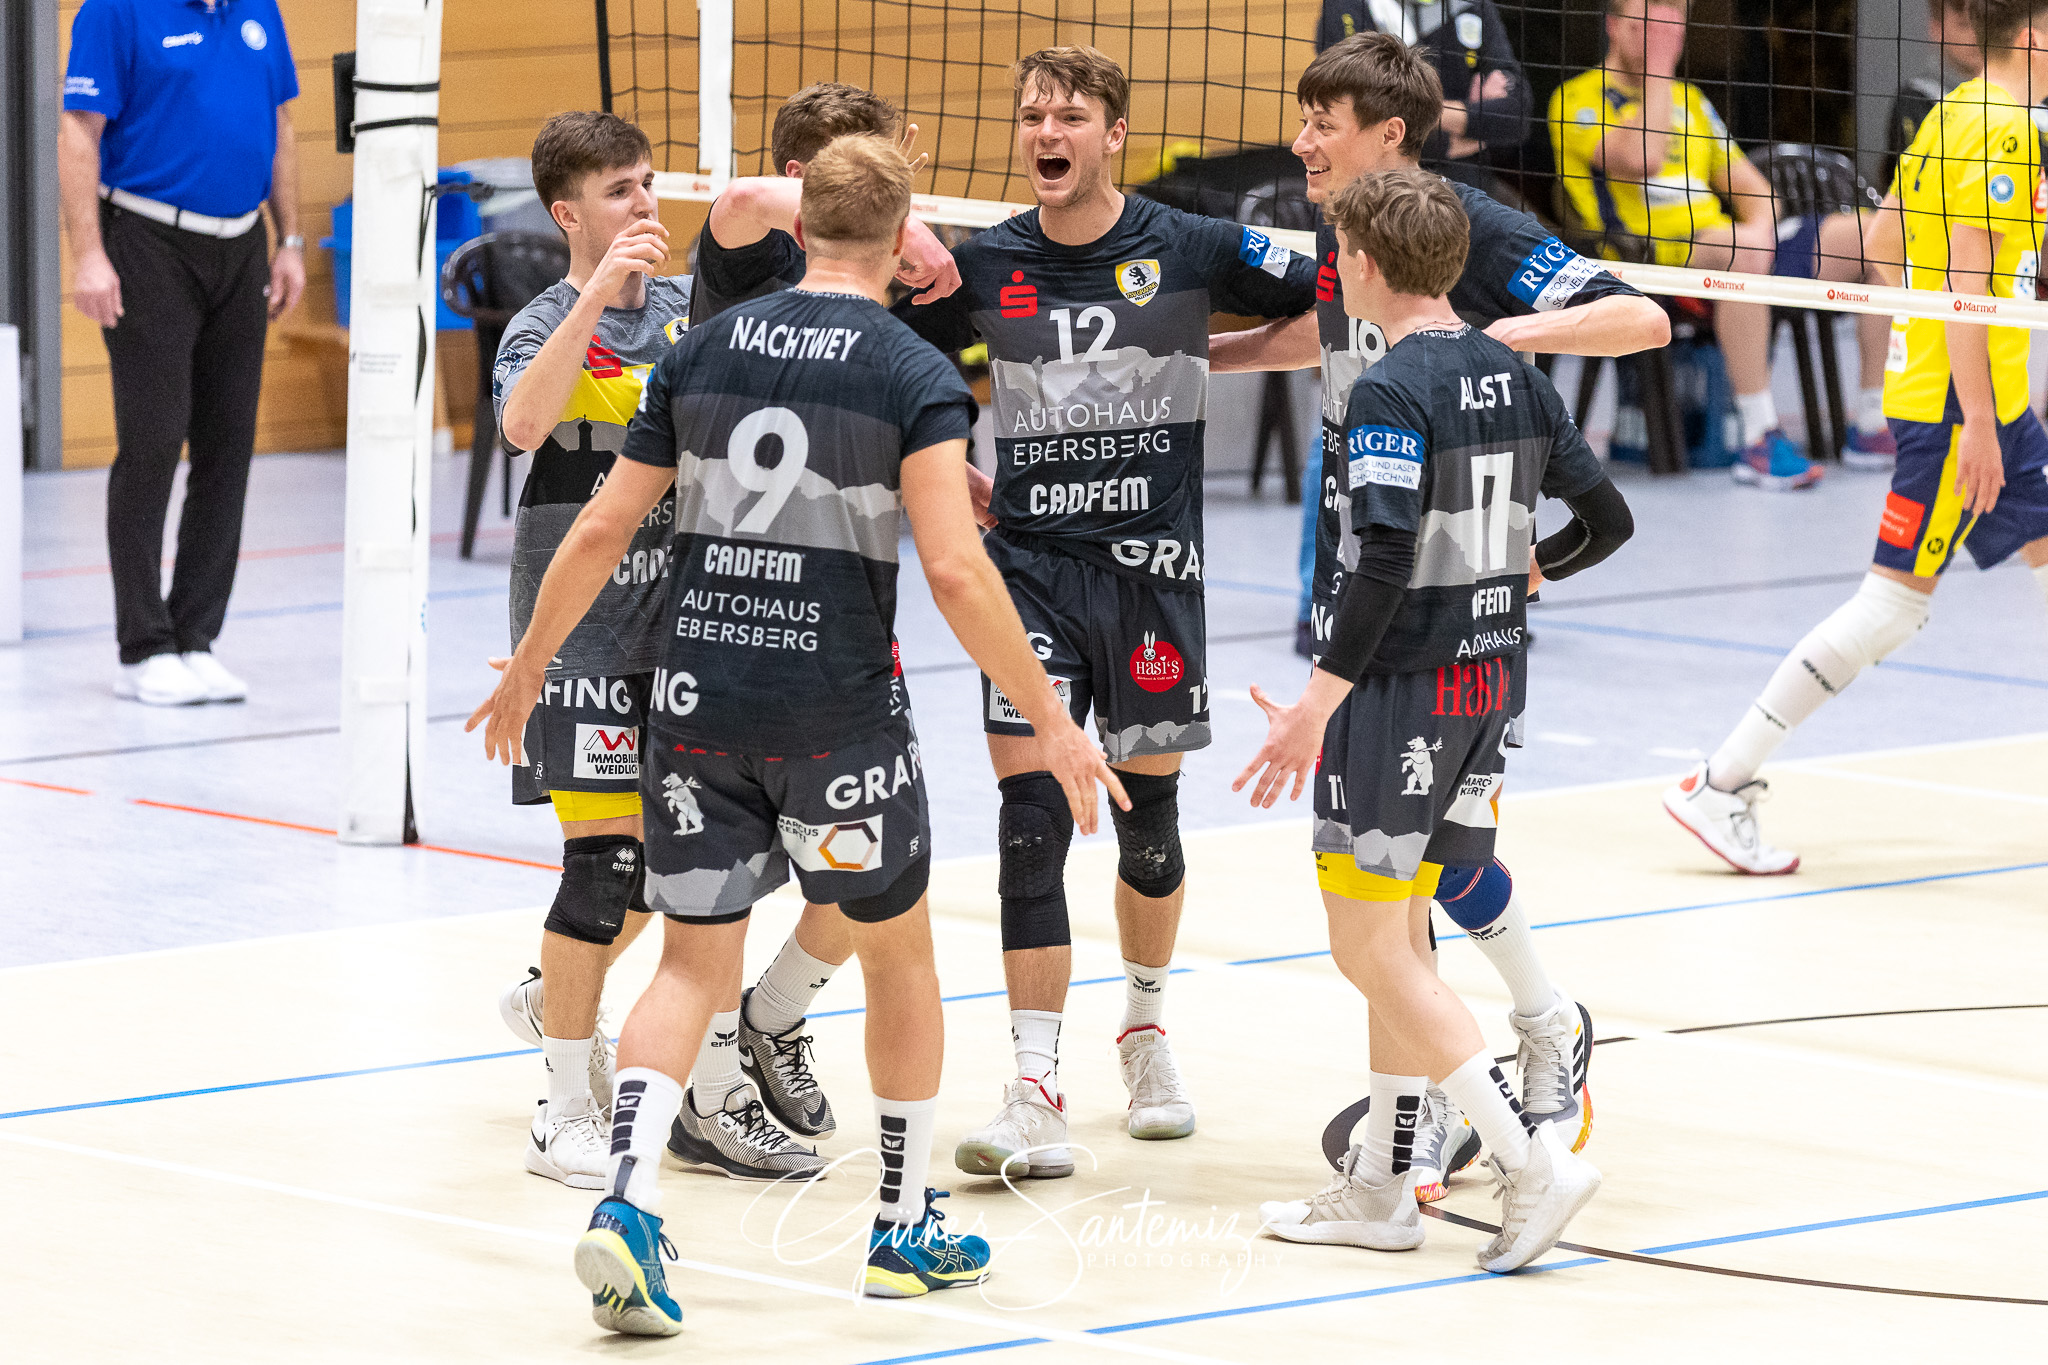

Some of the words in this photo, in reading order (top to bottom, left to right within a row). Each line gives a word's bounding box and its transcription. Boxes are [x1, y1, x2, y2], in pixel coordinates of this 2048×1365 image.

[1519, 236, 1578, 292] RÜG
[1712, 281, 1745, 291] Marmot
[1836, 291, 1869, 303] Marmot
[1963, 302, 1997, 313] Marmot
[729, 316, 862, 362] NACHTWEY
[1049, 305, 1119, 365] 12
[1014, 396, 1172, 433] AUTOHAUS
[1013, 430, 1171, 466] EBERSBERG
[727, 406, 809, 534] 9
[1030, 476, 1149, 516] CADFEM
[704, 543, 801, 583] CADFEM
[681, 589, 821, 623] AUTOHAUS
[676, 617, 818, 652] EBERSBERG
[1133, 982, 1161, 993] erima
